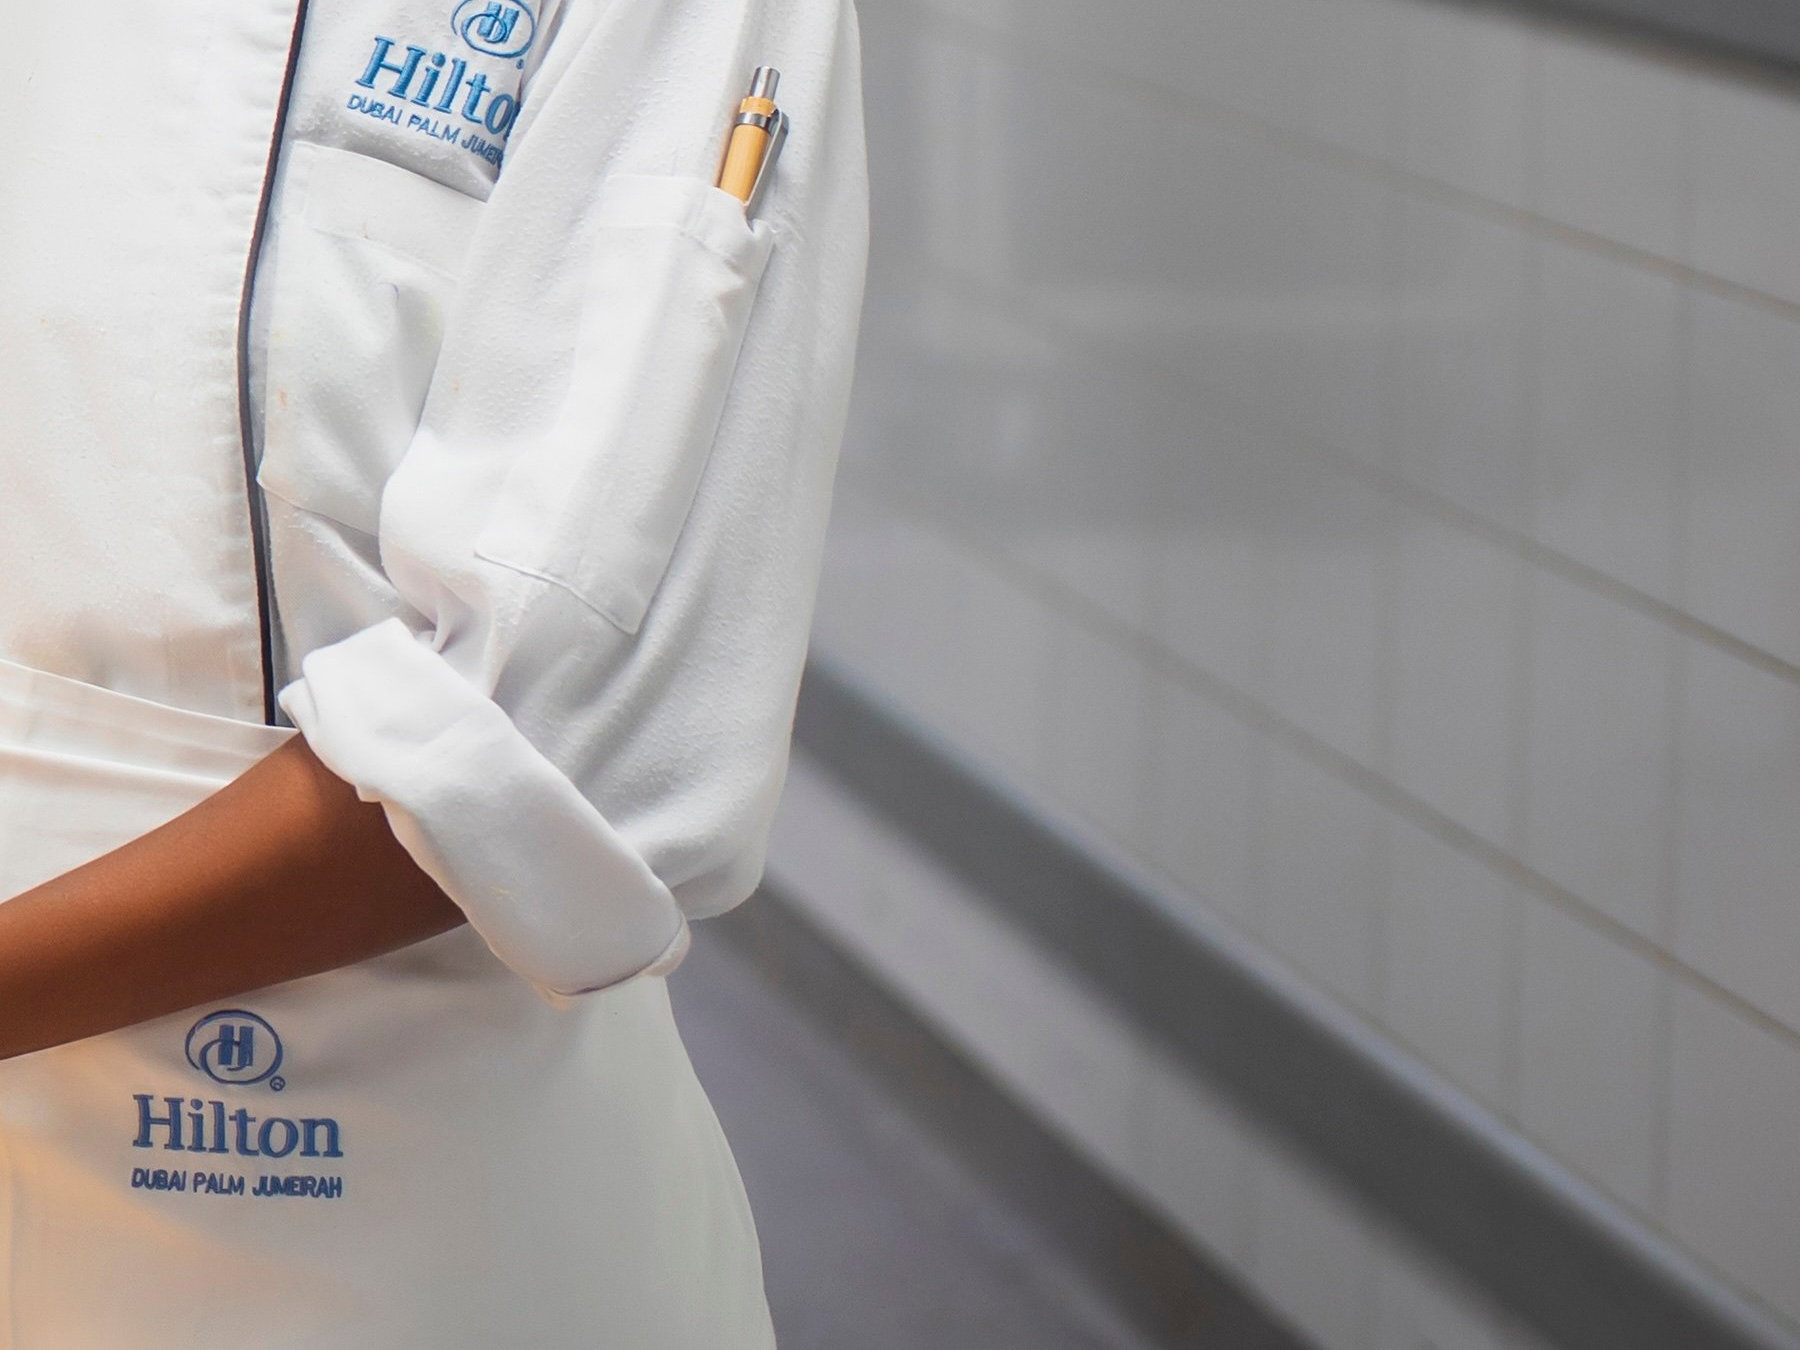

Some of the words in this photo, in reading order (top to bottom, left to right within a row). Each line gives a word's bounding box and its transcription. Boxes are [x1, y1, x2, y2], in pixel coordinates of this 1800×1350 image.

[346, 93, 403, 125] DUBAI
[407, 113, 462, 145] PALM
[132, 1093, 344, 1158] Hilton
[130, 1167, 187, 1192] DUBAI
[192, 1171, 246, 1196] PALM
[252, 1175, 344, 1199] JUMEIRAH
